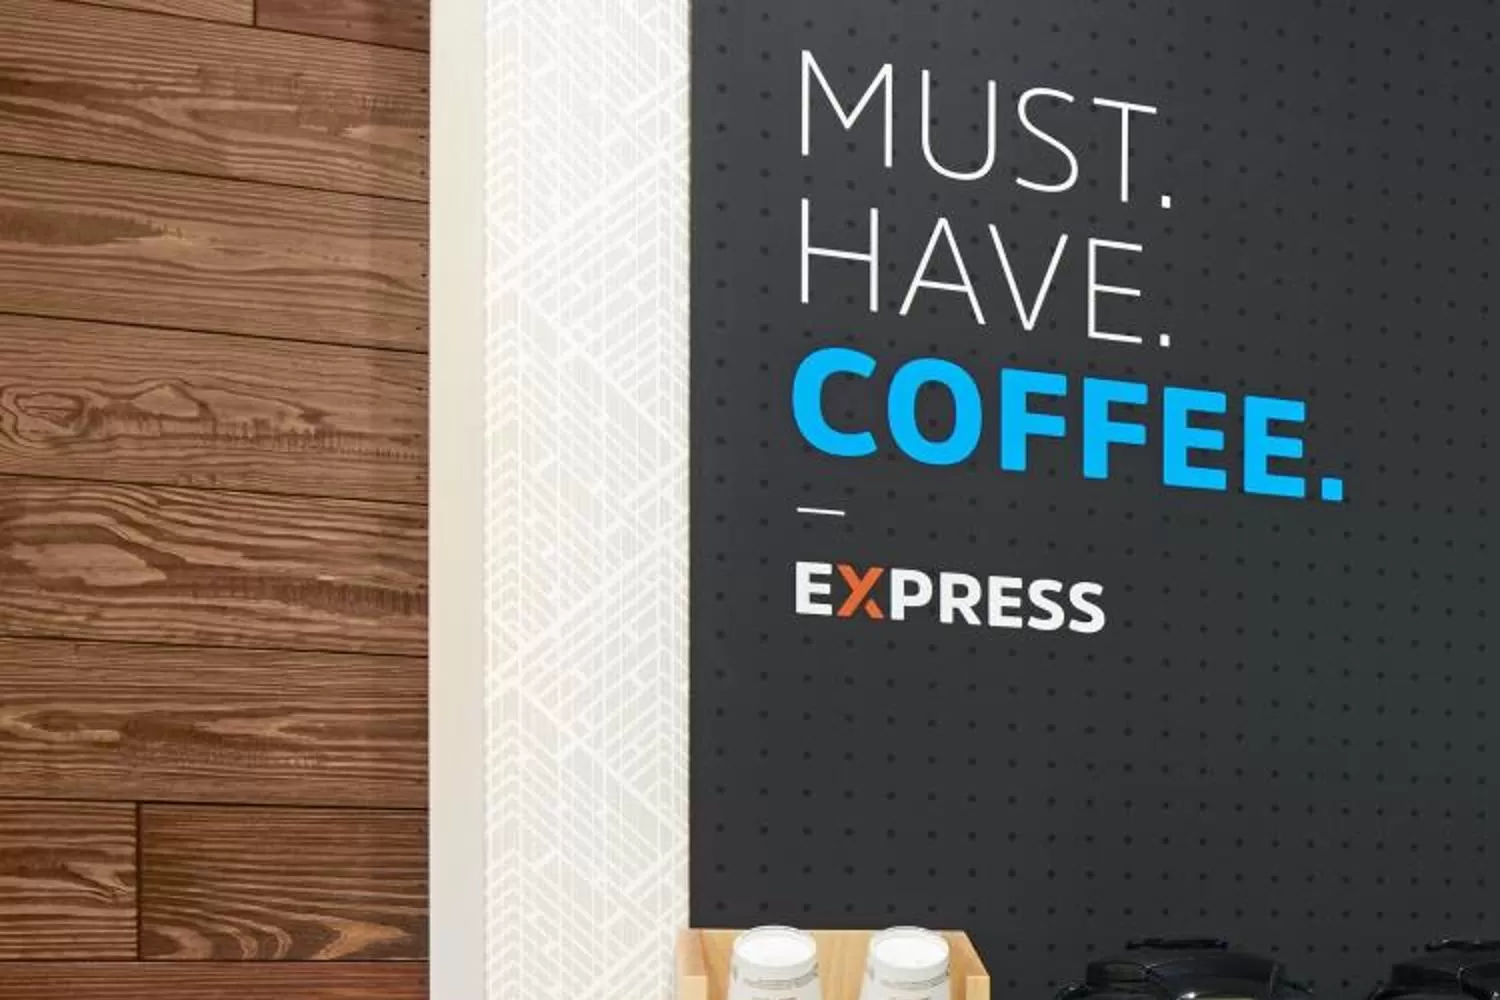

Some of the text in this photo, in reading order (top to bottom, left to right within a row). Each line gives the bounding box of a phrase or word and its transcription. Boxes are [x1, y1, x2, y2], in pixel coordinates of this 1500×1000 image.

[801, 49, 1172, 209] MUST.
[801, 197, 1171, 347] HAVE.
[791, 346, 1343, 502] COFFEE.
[795, 560, 1106, 634] EXPRESS
